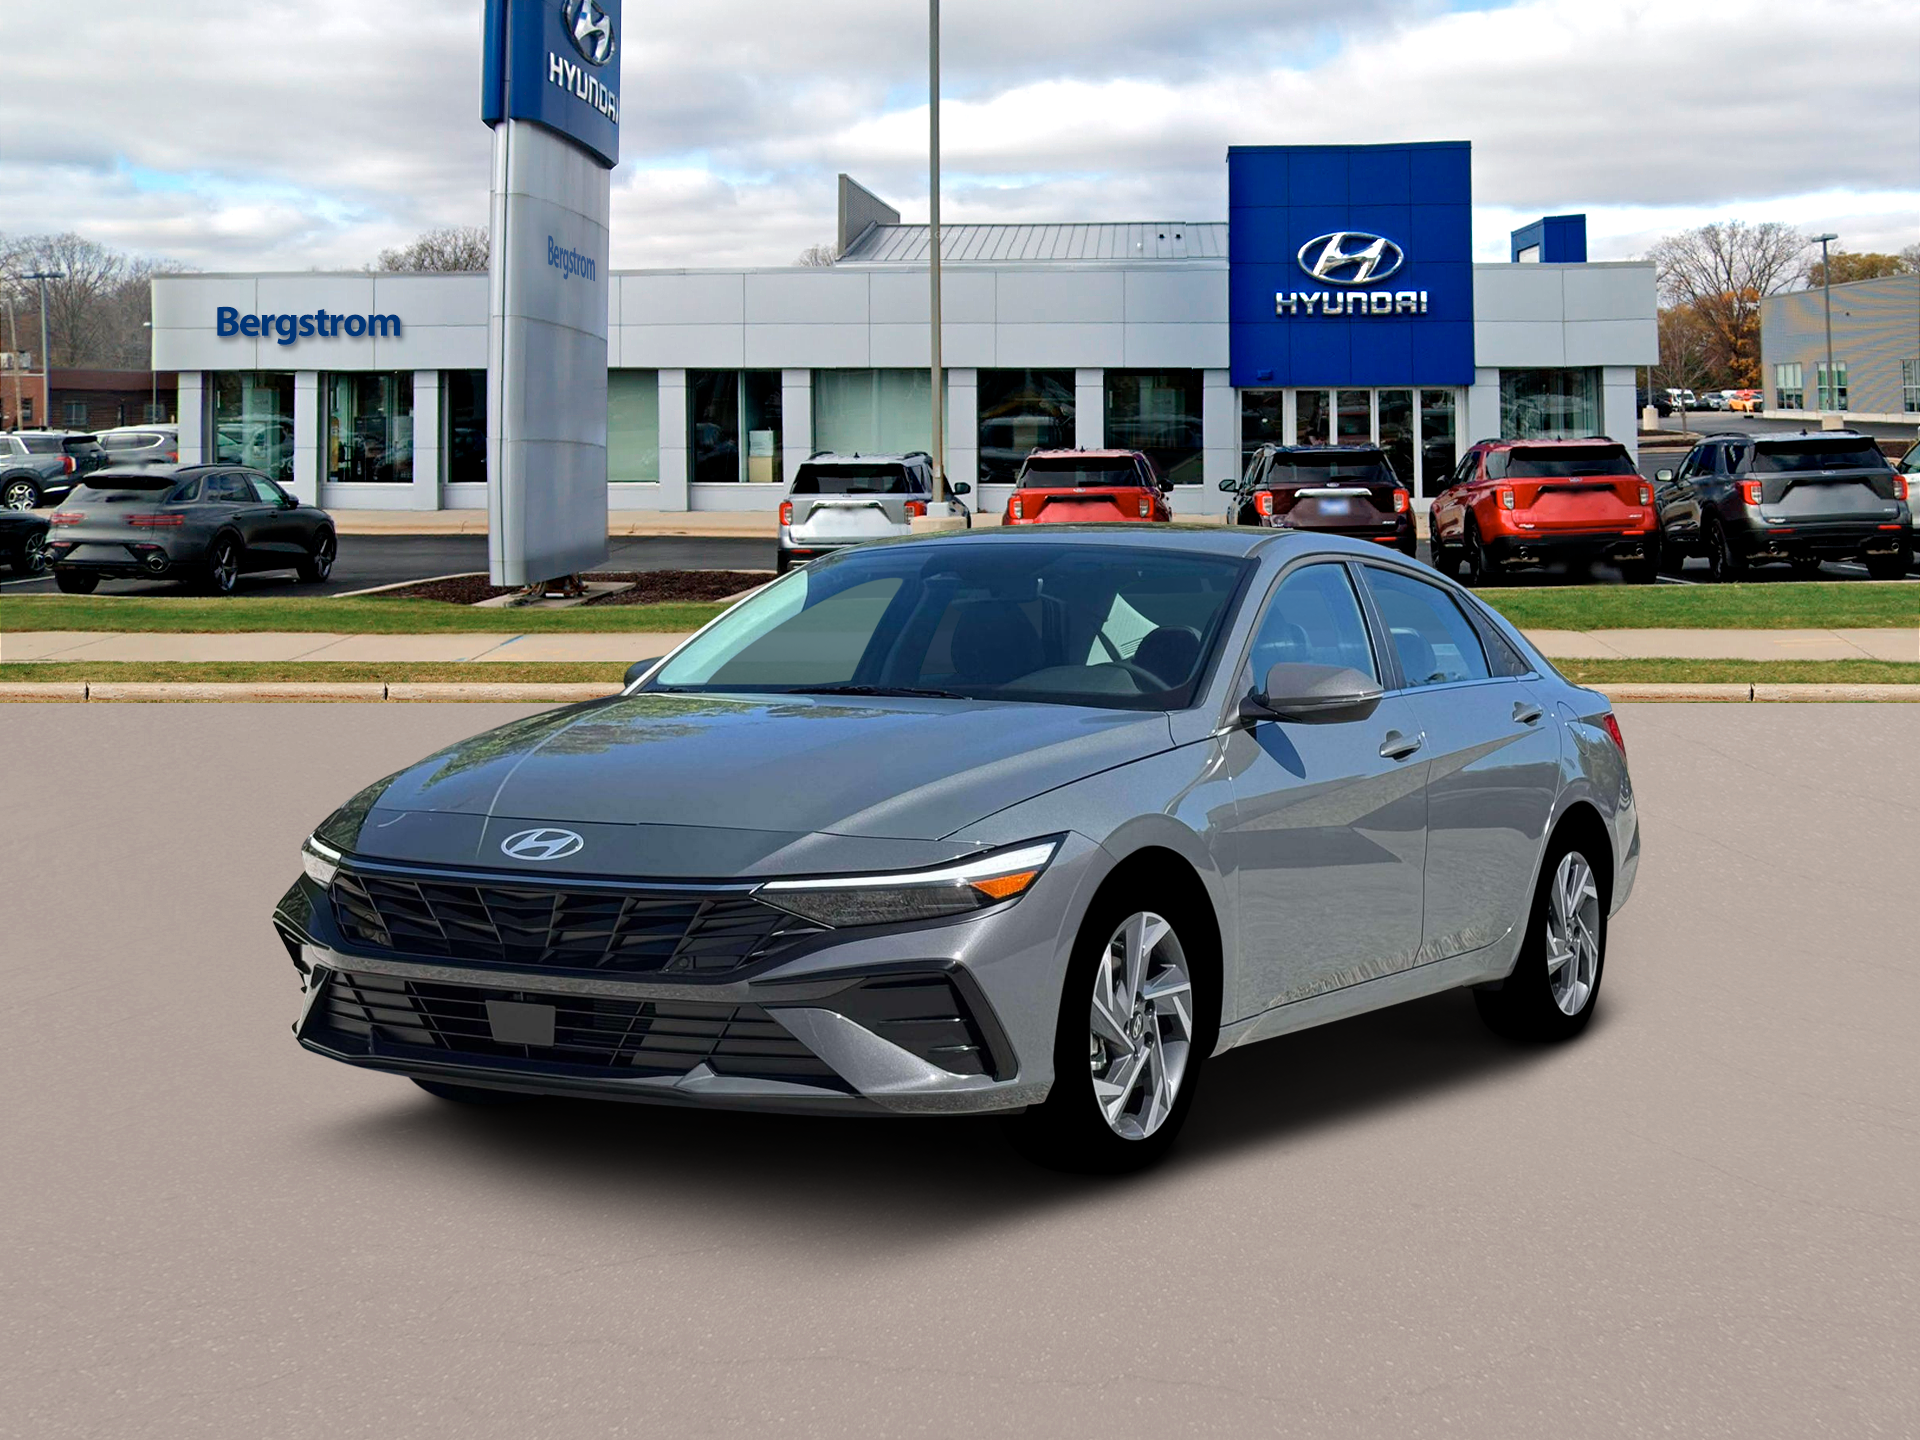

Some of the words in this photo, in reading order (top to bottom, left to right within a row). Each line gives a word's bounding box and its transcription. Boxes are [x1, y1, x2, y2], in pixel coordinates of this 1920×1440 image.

[548, 52, 619, 124] HYUNDAI
[547, 235, 596, 281] Bergstrom
[1275, 291, 1428, 315] HYUNDAI
[216, 306, 402, 346] Bergstrom
